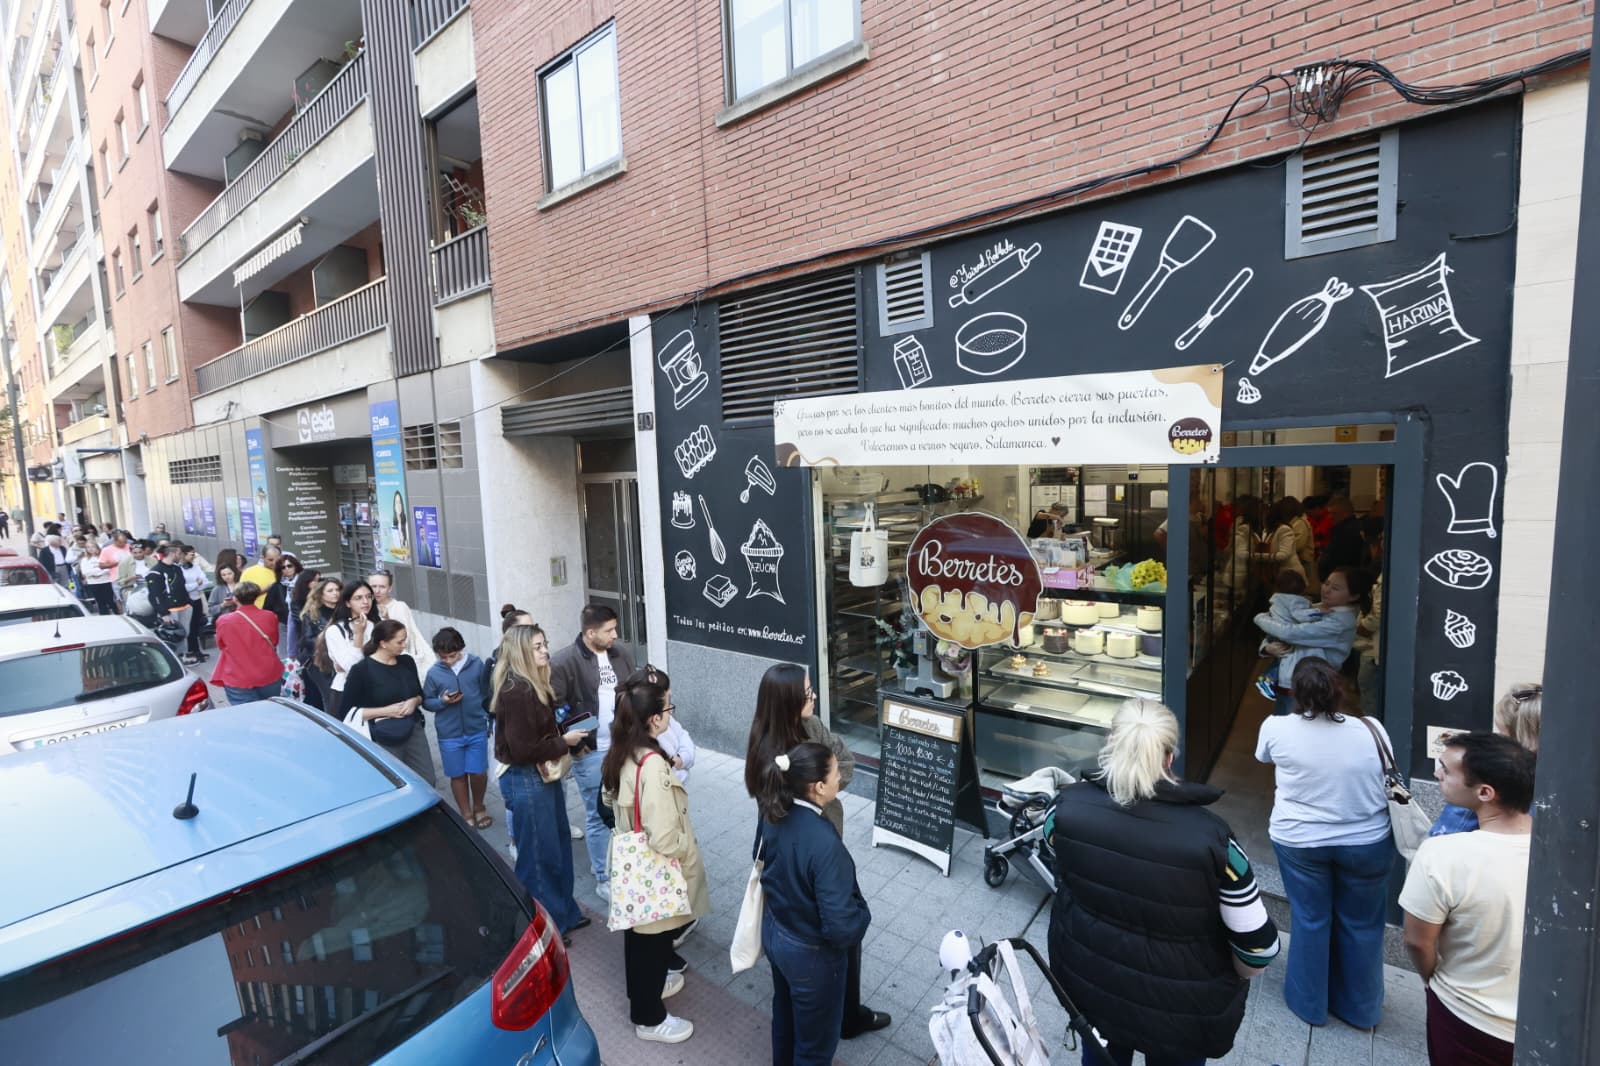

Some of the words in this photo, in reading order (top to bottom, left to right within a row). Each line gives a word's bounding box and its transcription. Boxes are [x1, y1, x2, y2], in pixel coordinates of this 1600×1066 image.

[1388, 297, 1450, 334] HARINA
[907, 350, 927, 383] LECHE
[854, 403, 866, 415] los
[867, 403, 897, 414] clientes
[899, 403, 917, 412] más
[919, 400, 952, 411] bonitos
[954, 395, 968, 409] del
[1058, 391, 1091, 403] cierra
[1096, 391, 1114, 401] sus
[797, 430, 813, 440] pero
[814, 429, 823, 437] no
[834, 424, 858, 435] acaba
[860, 422, 868, 433] lo
[869, 426, 882, 436] que
[884, 420, 896, 432] ha
[952, 416, 988, 429] muchos
[991, 415, 1025, 431] gochos
[1028, 412, 1066, 426] unidos
[1068, 415, 1088, 429] por
[1091, 410, 1103, 424] la
[860, 439, 908, 451] Volveremos
[918, 442, 946, 451] vernos
[751, 557, 776, 574] AZÚCAR
[918, 539, 1024, 586] Berretès
[695, 618, 705, 629] los
[708, 621, 735, 633] pedidos
